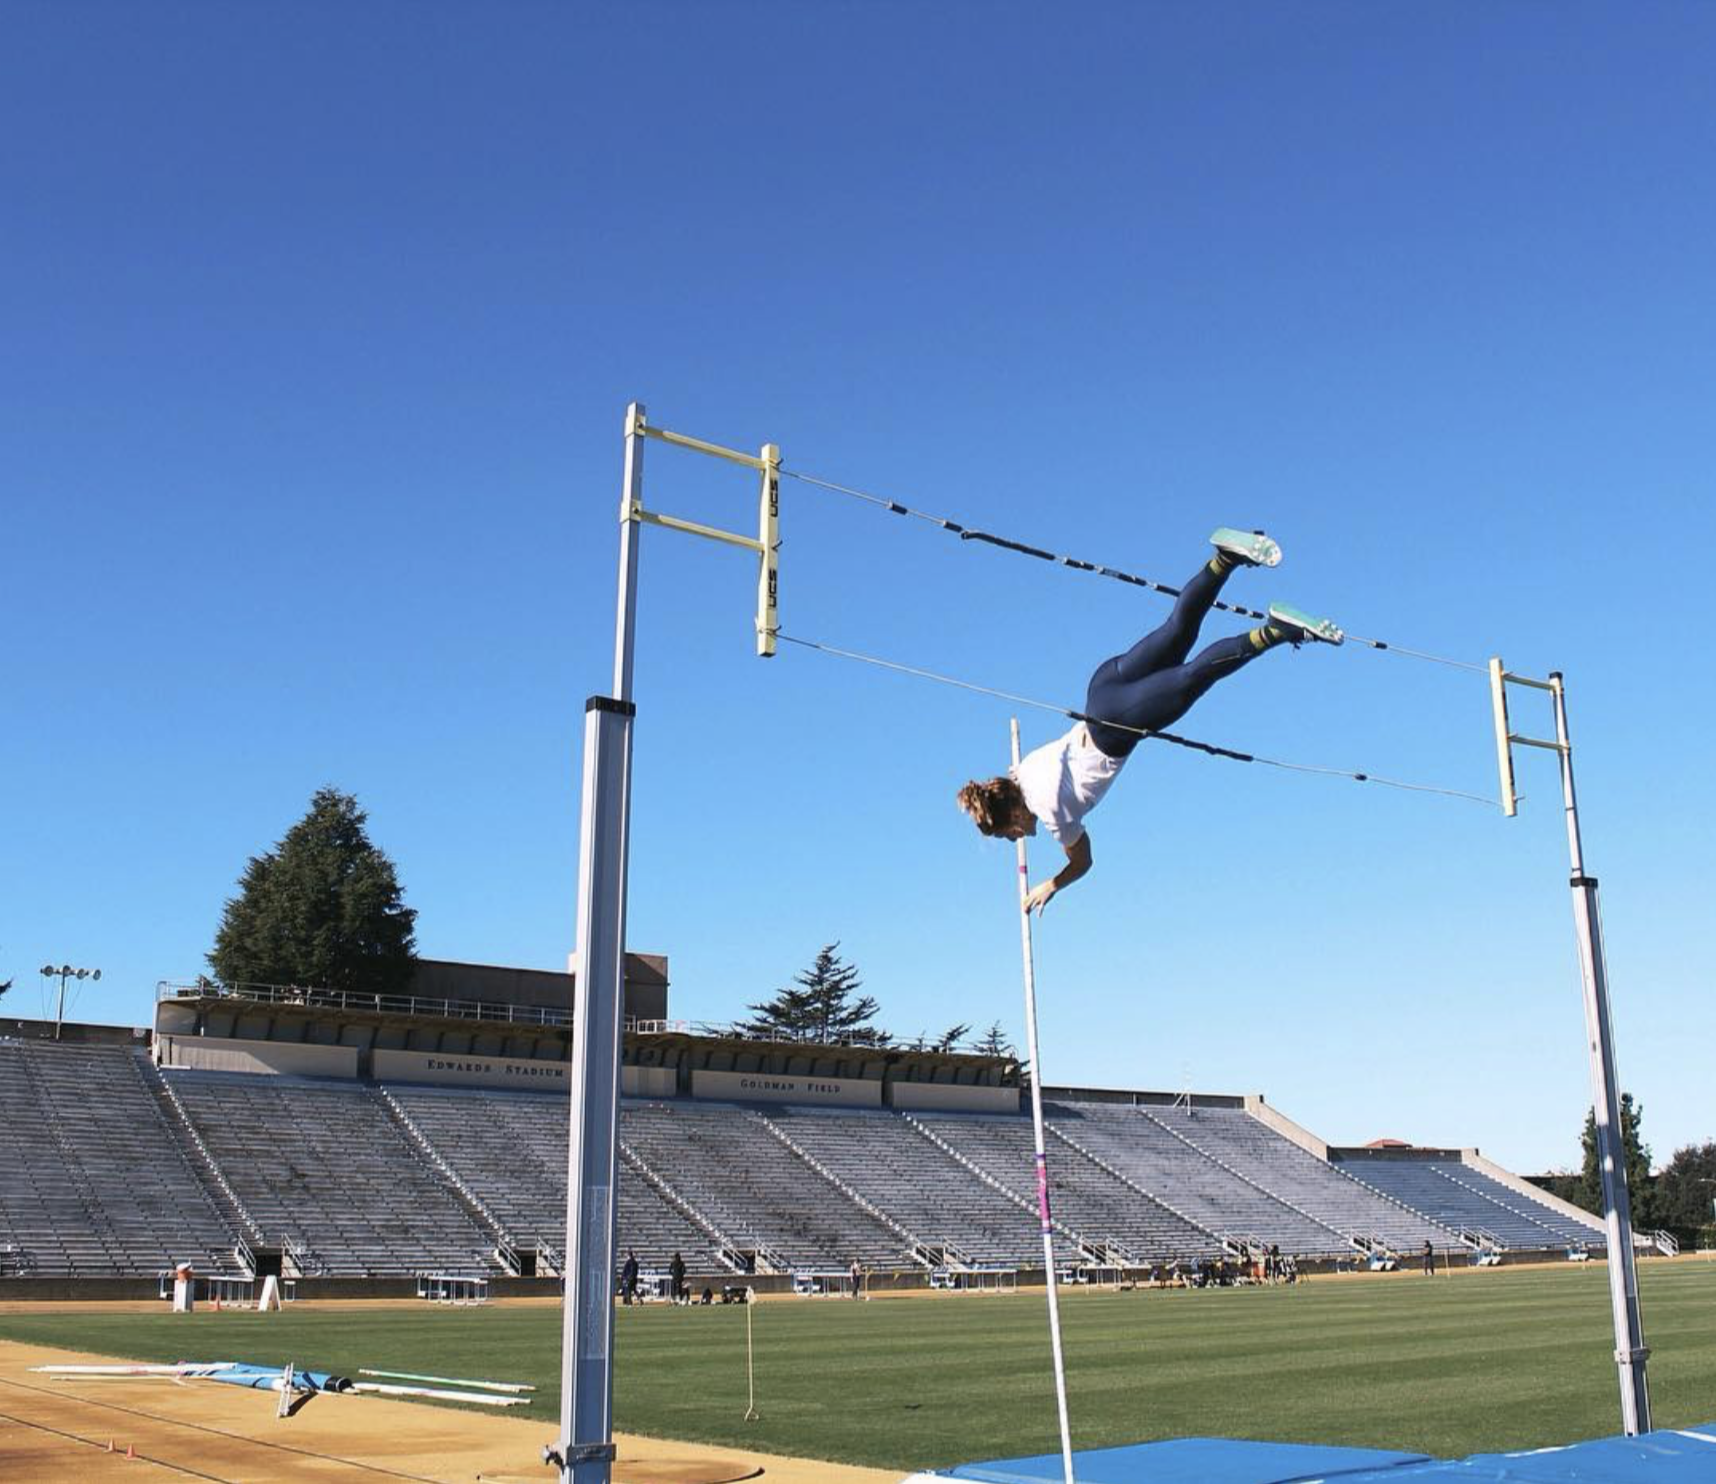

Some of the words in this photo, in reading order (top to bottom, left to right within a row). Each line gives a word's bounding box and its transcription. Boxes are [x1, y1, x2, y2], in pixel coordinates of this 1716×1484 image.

[769, 479, 778, 518] UCS
[768, 568, 777, 608] UCS
[427, 1059, 491, 1072] EDWARDS
[505, 1065, 563, 1077] STADIUM
[741, 1079, 795, 1091] GOLDMAN
[808, 1083, 841, 1093] FIELD
